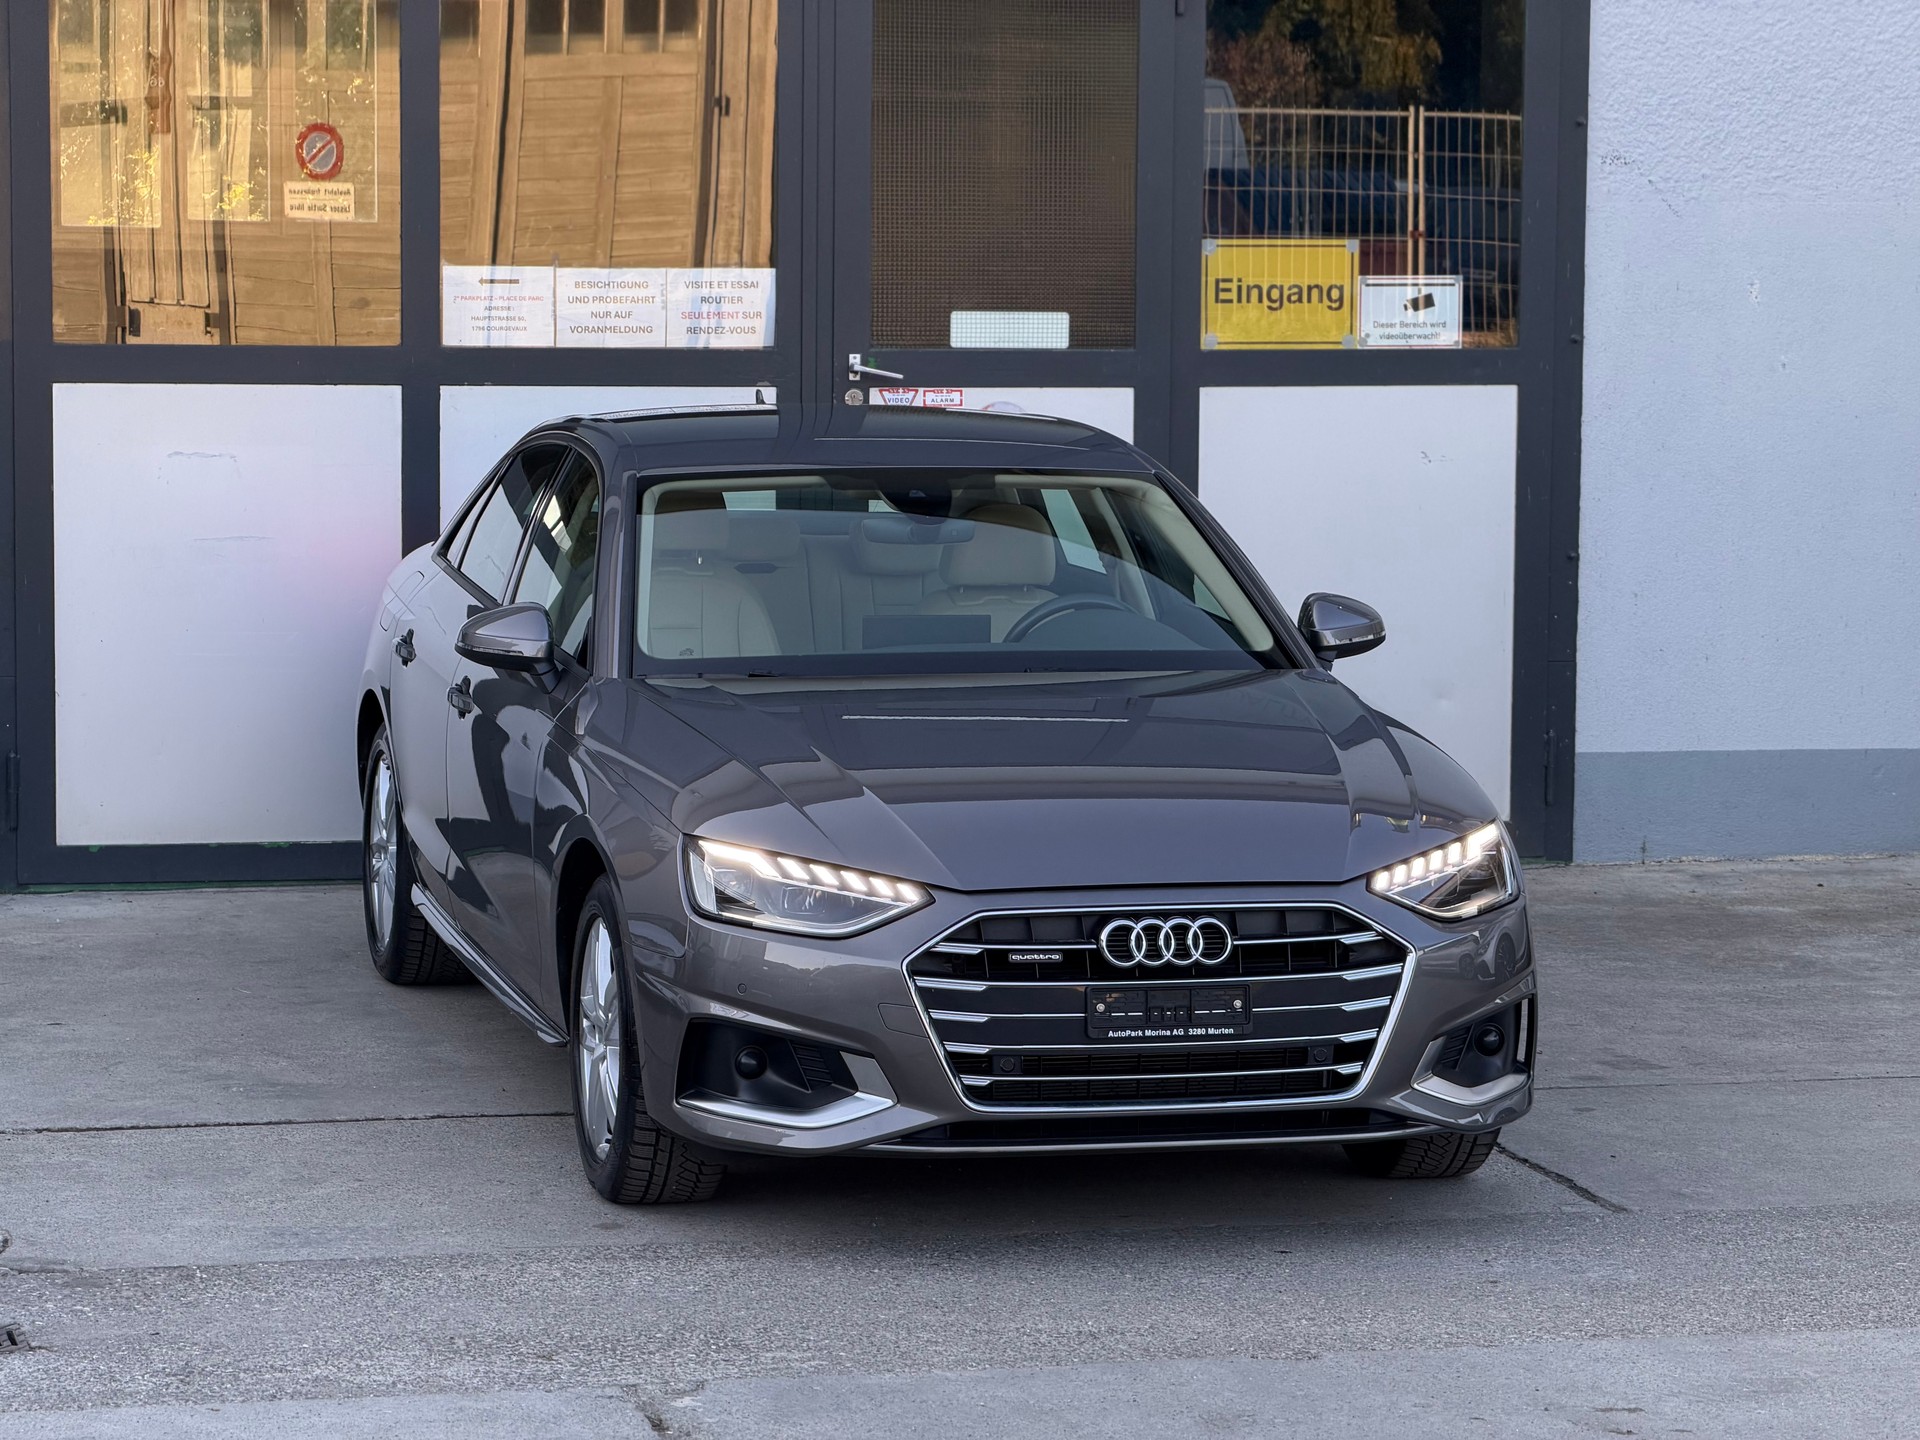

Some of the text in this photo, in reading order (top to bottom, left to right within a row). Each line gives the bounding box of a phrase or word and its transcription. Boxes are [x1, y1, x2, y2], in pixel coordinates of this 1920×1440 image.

[574, 280, 649, 289] BESICHTIGUNG
[684, 280, 759, 289] VISITE ET ESSAI
[1214, 277, 1345, 312] Eingang
[567, 295, 656, 304] UND PROBEFAHRT
[700, 296, 743, 304] ROUTIER
[590, 310, 633, 319] NUR AUF
[680, 311, 762, 320] SEULEMENT SUR
[1373, 320, 1447, 329] Dieser Bereich wird
[569, 325, 654, 334] VORANMELDUNG
[686, 326, 757, 335] RENDEZ-VOUS
[1379, 331, 1441, 340] videoüberwacht!
[1011, 953, 1060, 961] quattro
[1108, 1029, 1143, 1038] AutoPark
[1144, 1029, 1171, 1037] Morina
[1172, 1028, 1185, 1036] AG
[1207, 1027, 1234, 1035] Murten
